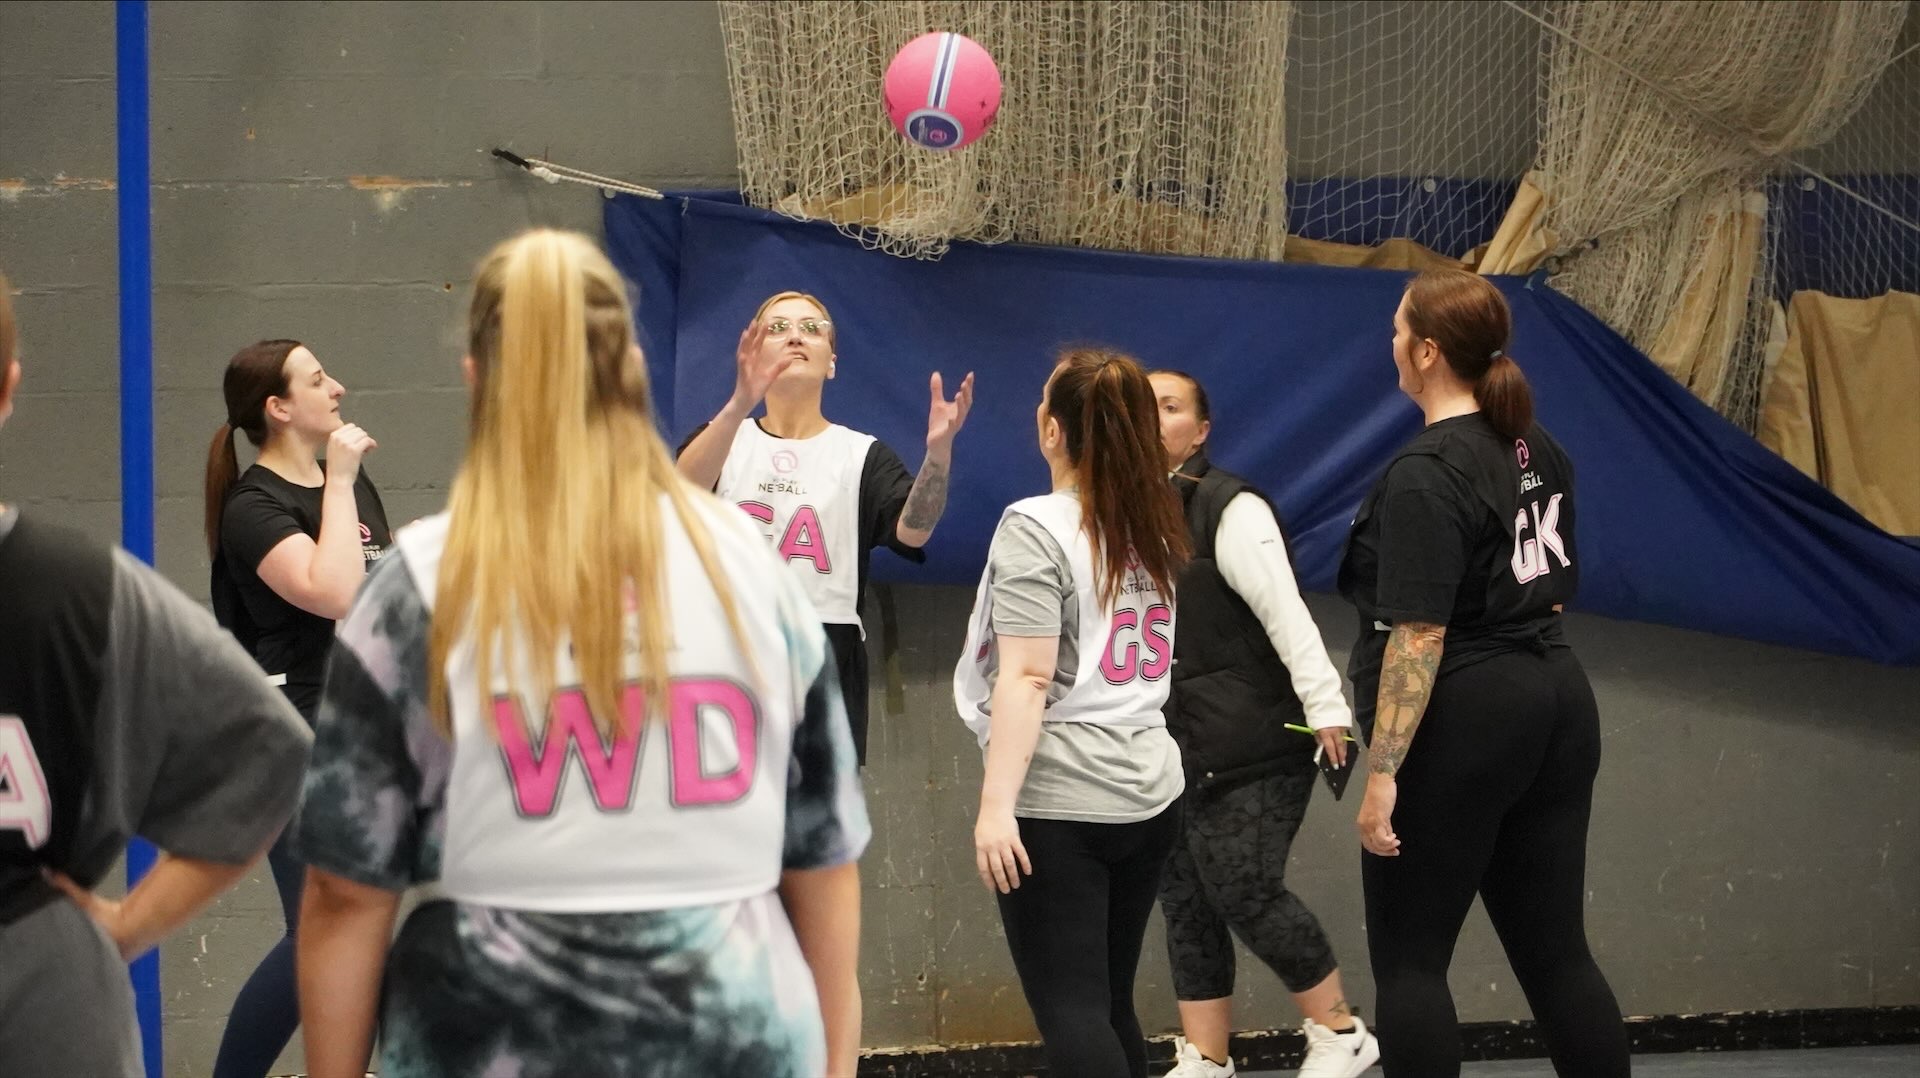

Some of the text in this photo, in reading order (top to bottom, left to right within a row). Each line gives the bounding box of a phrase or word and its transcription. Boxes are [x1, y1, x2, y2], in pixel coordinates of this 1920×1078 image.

[758, 483, 808, 495] NEBALL
[1520, 474, 1543, 494] TBALL
[1511, 493, 1571, 584] GK
[1098, 603, 1171, 685] GS
[488, 674, 763, 819] WD
